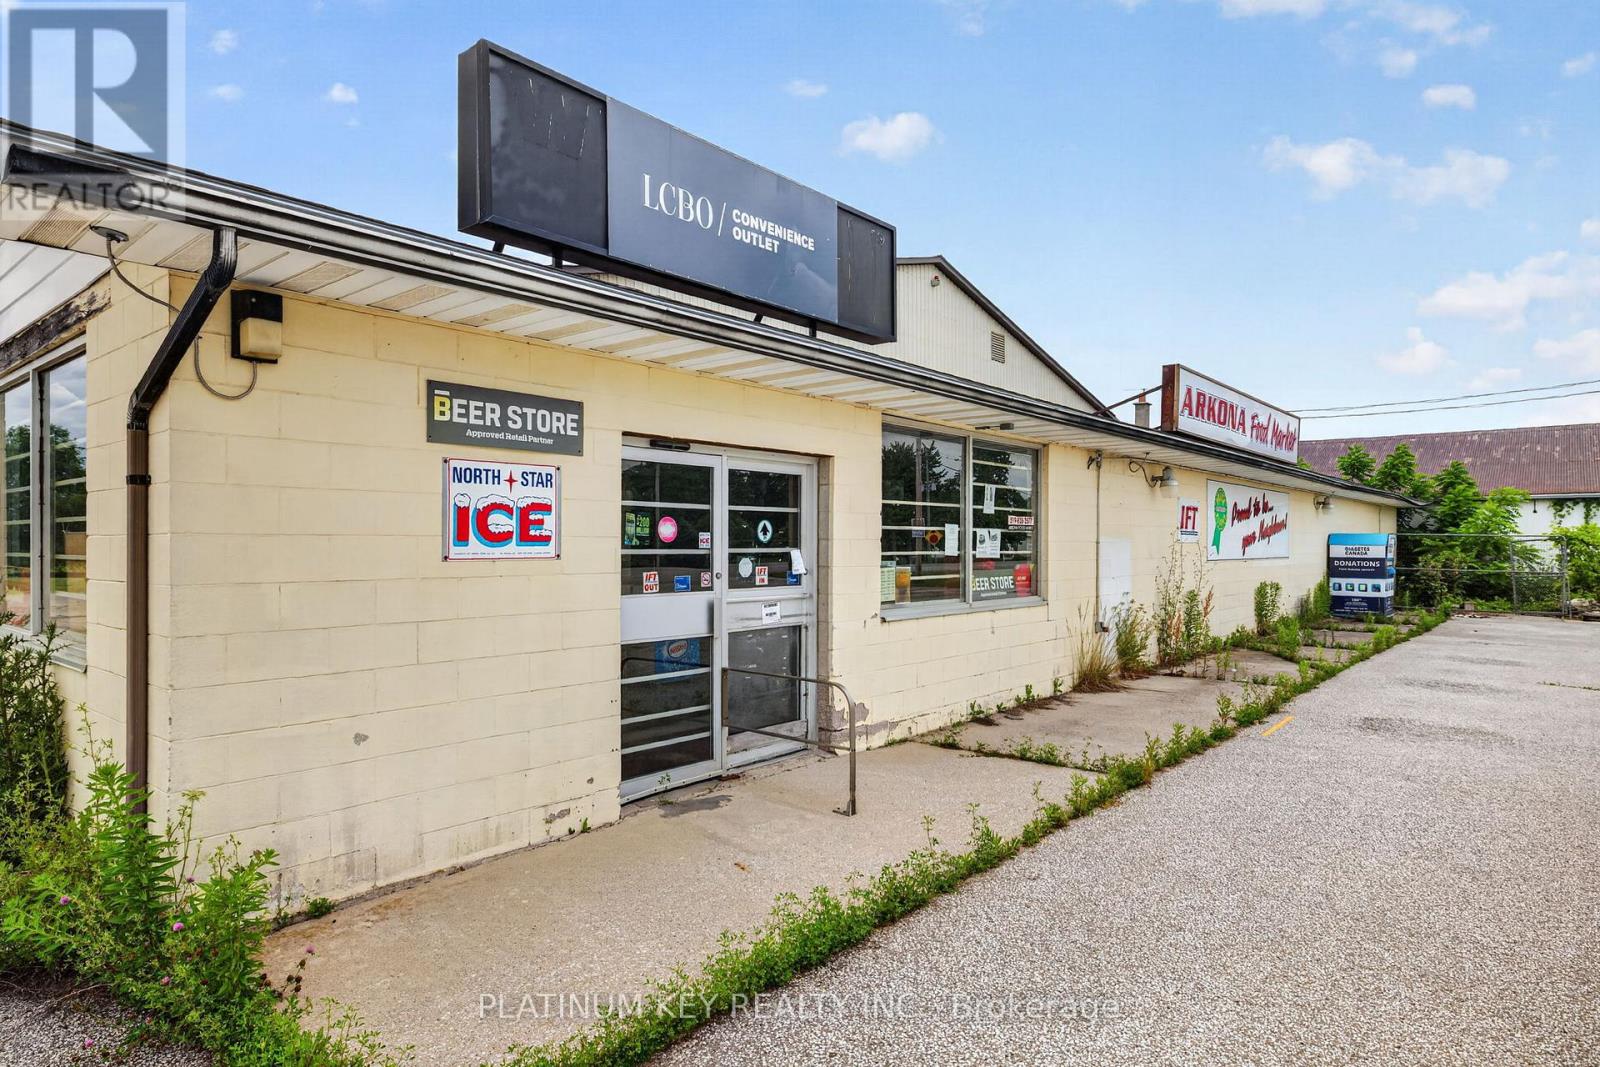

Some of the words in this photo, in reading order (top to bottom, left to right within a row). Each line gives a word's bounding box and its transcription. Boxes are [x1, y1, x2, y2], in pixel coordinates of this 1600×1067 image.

[643, 173, 713, 229] LCBO
[732, 209, 815, 251] CONVENIENCE
[732, 227, 779, 253] OUTLET
[434, 389, 501, 427] BEER
[507, 405, 579, 436] STORE
[1180, 385, 1246, 436] ARKONA
[1251, 413, 1271, 447] Food
[1271, 418, 1296, 451] Market
[466, 428, 505, 440] Approved
[505, 432, 528, 443] Retail
[528, 435, 553, 445] Partner
[453, 466, 501, 485] NORTH
[521, 471, 553, 488] STAR
[453, 493, 553, 548] ICE
[990, 575, 1014, 590] STORE
